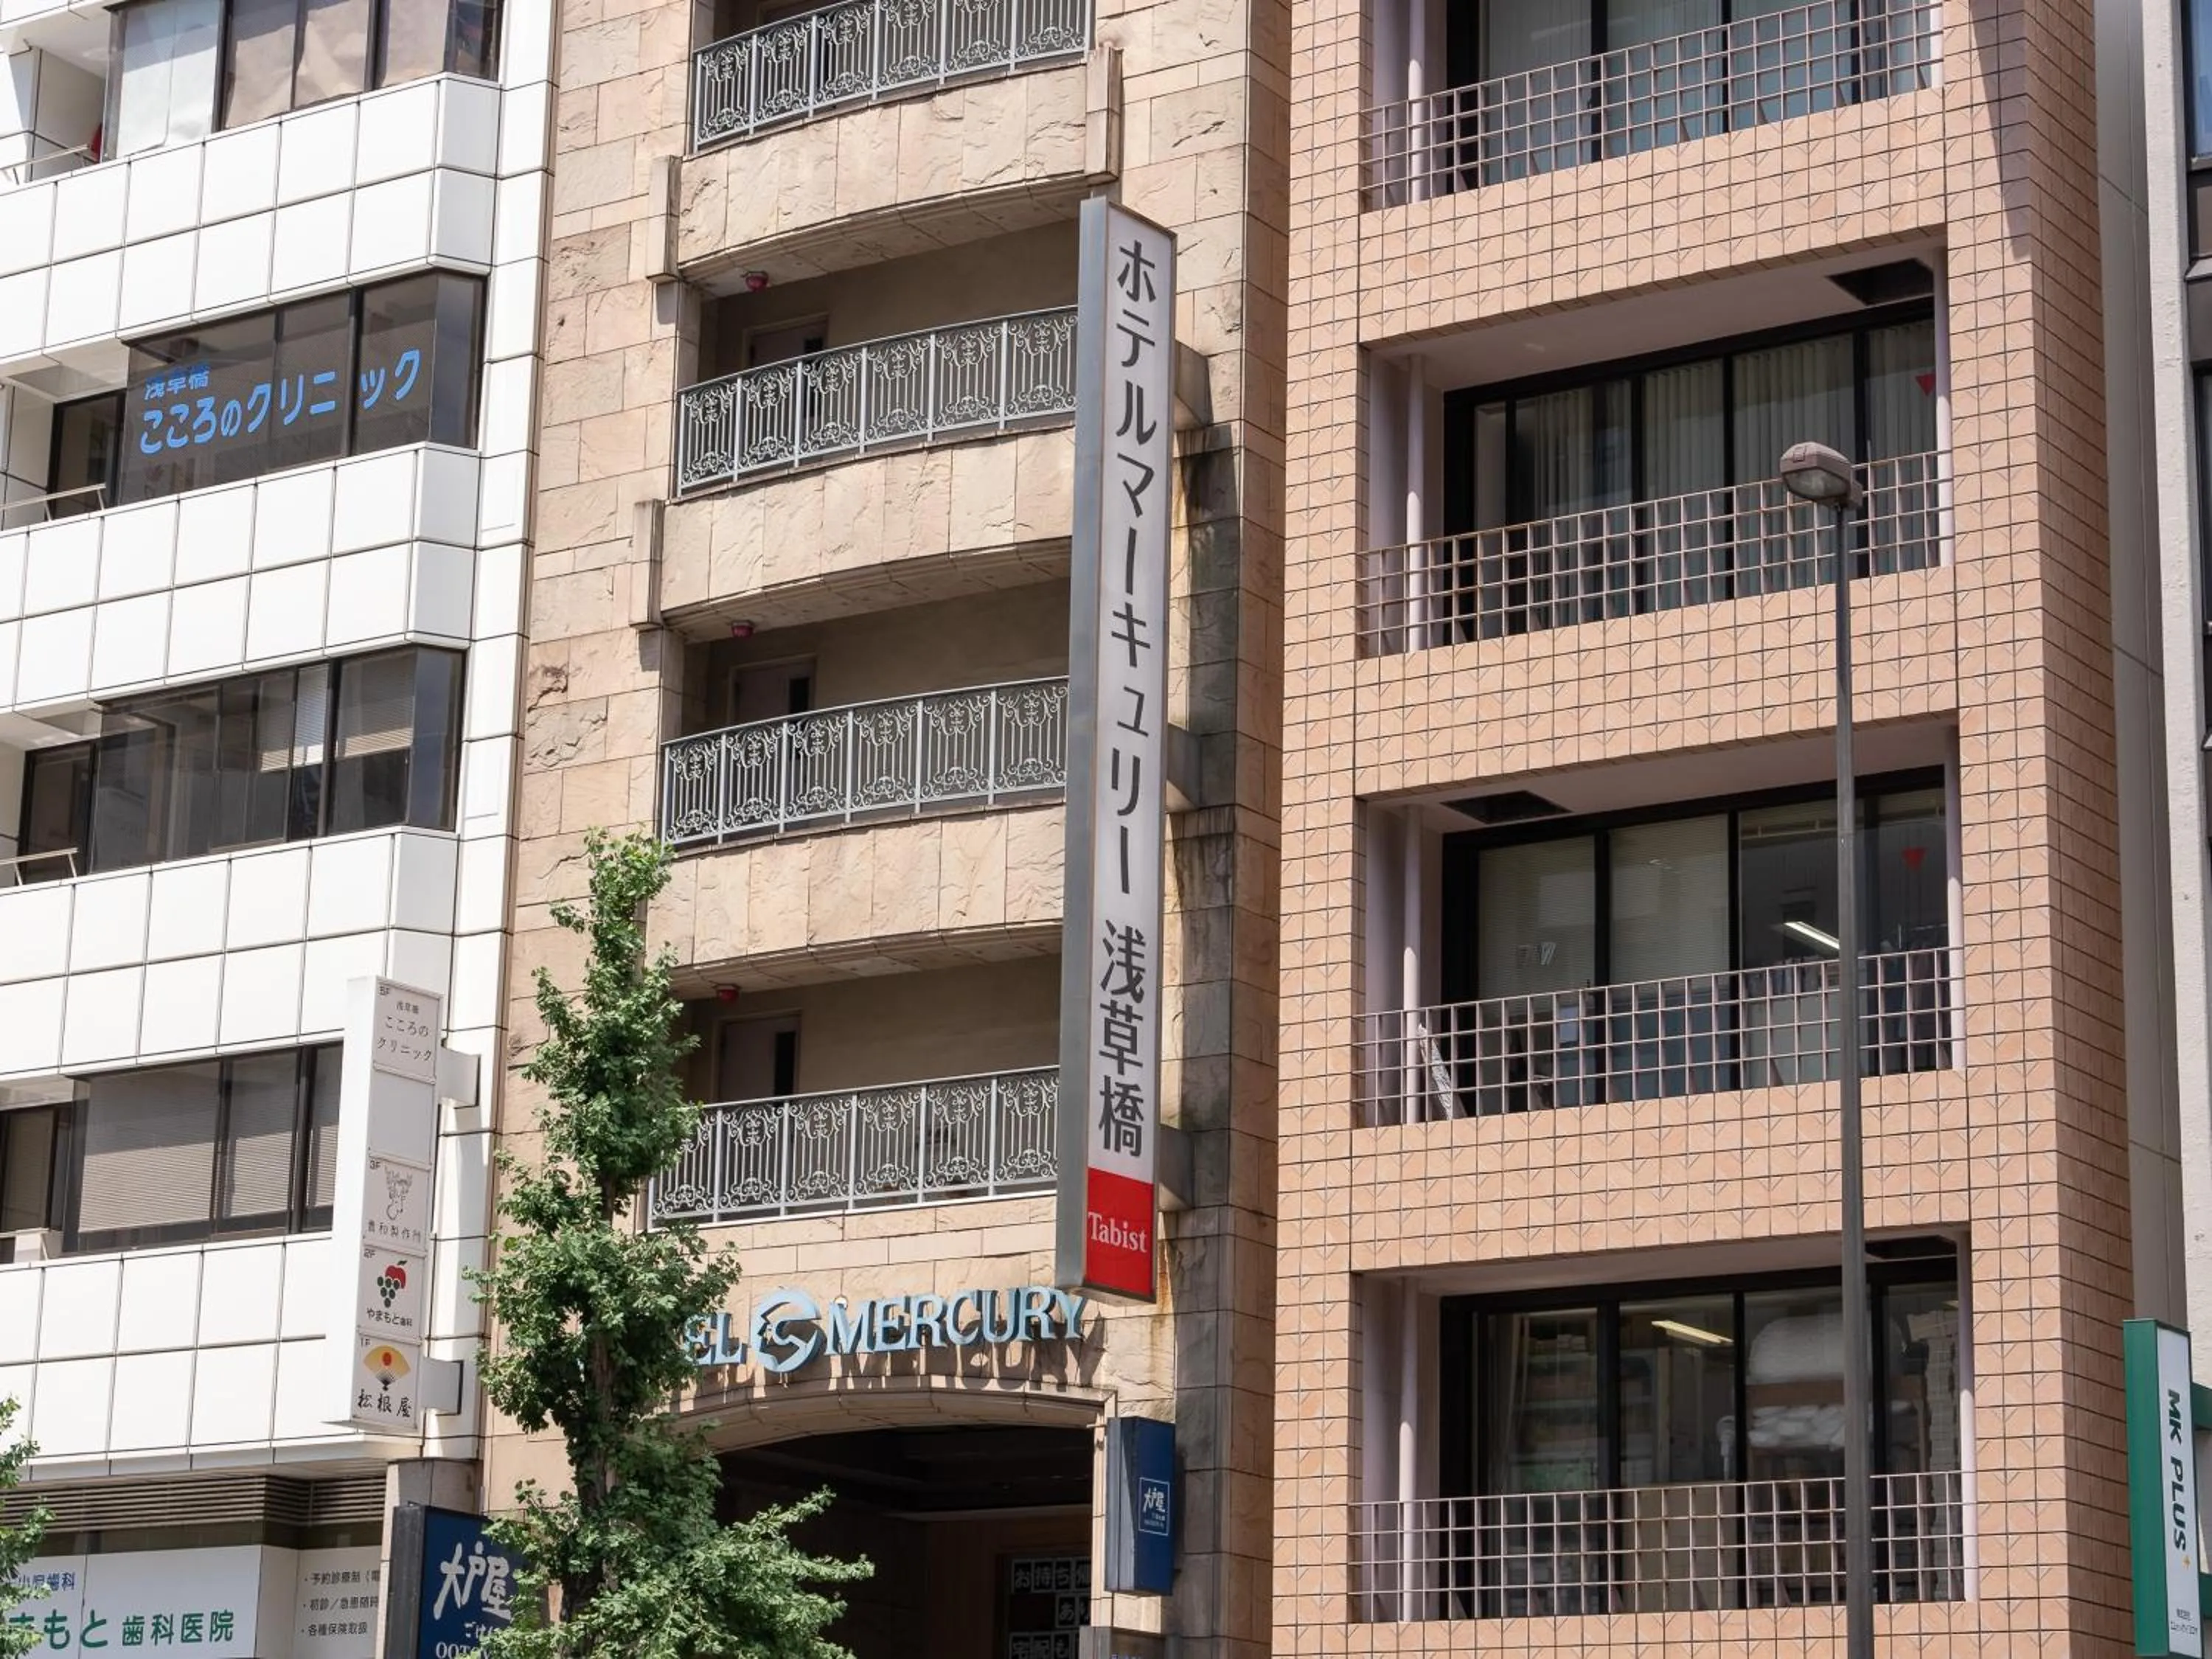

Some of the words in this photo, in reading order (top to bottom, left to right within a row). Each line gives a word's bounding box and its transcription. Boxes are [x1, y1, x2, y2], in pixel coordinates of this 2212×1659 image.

[140, 348, 421, 455] こころのクリニック
[1111, 239, 1157, 894] ホテルマーキュリー
[377, 1037, 431, 1062] クリニック
[385, 1016, 429, 1037] こころの
[1099, 919, 1147, 1158] 浅草橋
[369, 1160, 381, 1170] 3F
[1088, 1211, 1147, 1253] Tabist
[361, 1338, 371, 1347] 1F
[824, 1286, 1087, 1356] MERCURY
[358, 1388, 411, 1417] 松根屋
[2168, 1388, 2183, 1445] MK
[2170, 1455, 2187, 1551] PLUS
[434, 1540, 512, 1621] 大戸屋
